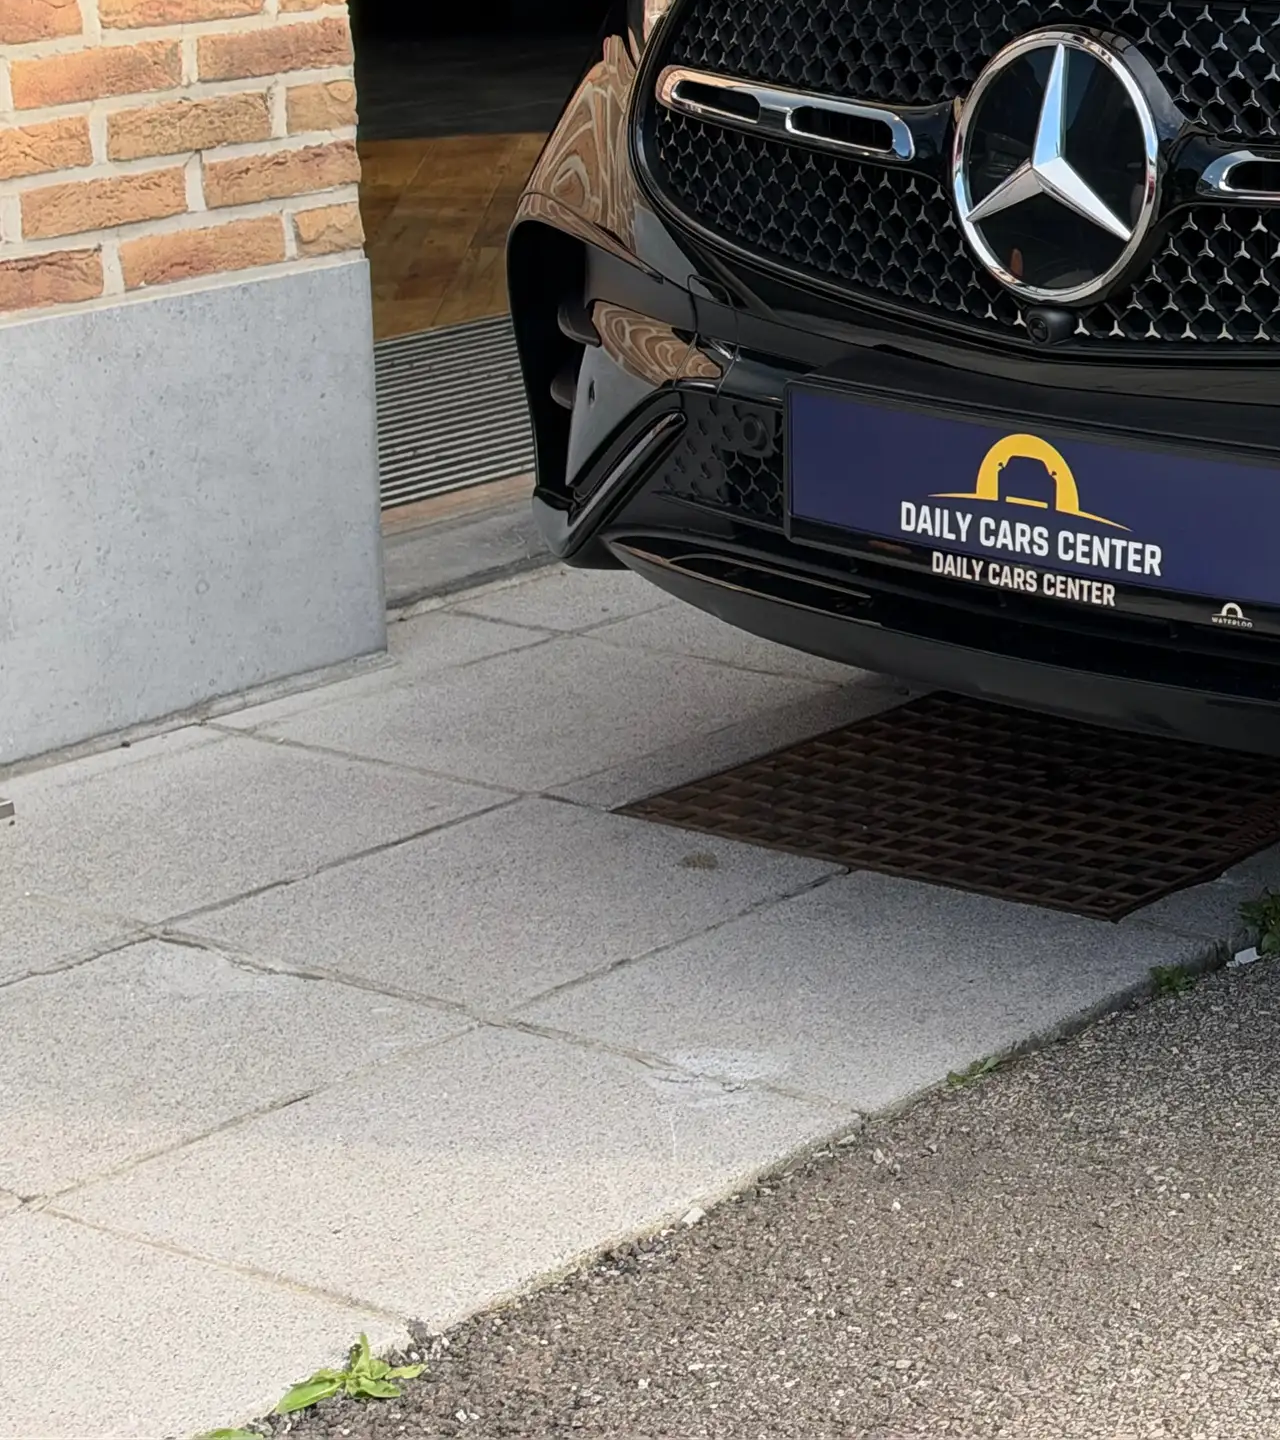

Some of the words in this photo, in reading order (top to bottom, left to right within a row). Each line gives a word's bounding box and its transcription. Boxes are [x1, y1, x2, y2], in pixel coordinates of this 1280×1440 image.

[900, 500, 973, 543] DAILY
[979, 516, 1049, 557] CARS
[1057, 529, 1163, 577] CENTER
[931, 550, 984, 582] DAILY
[988, 562, 1038, 593] CARS
[1042, 573, 1116, 607] CENTER
[1211, 616, 1253, 629] WATERLOO
